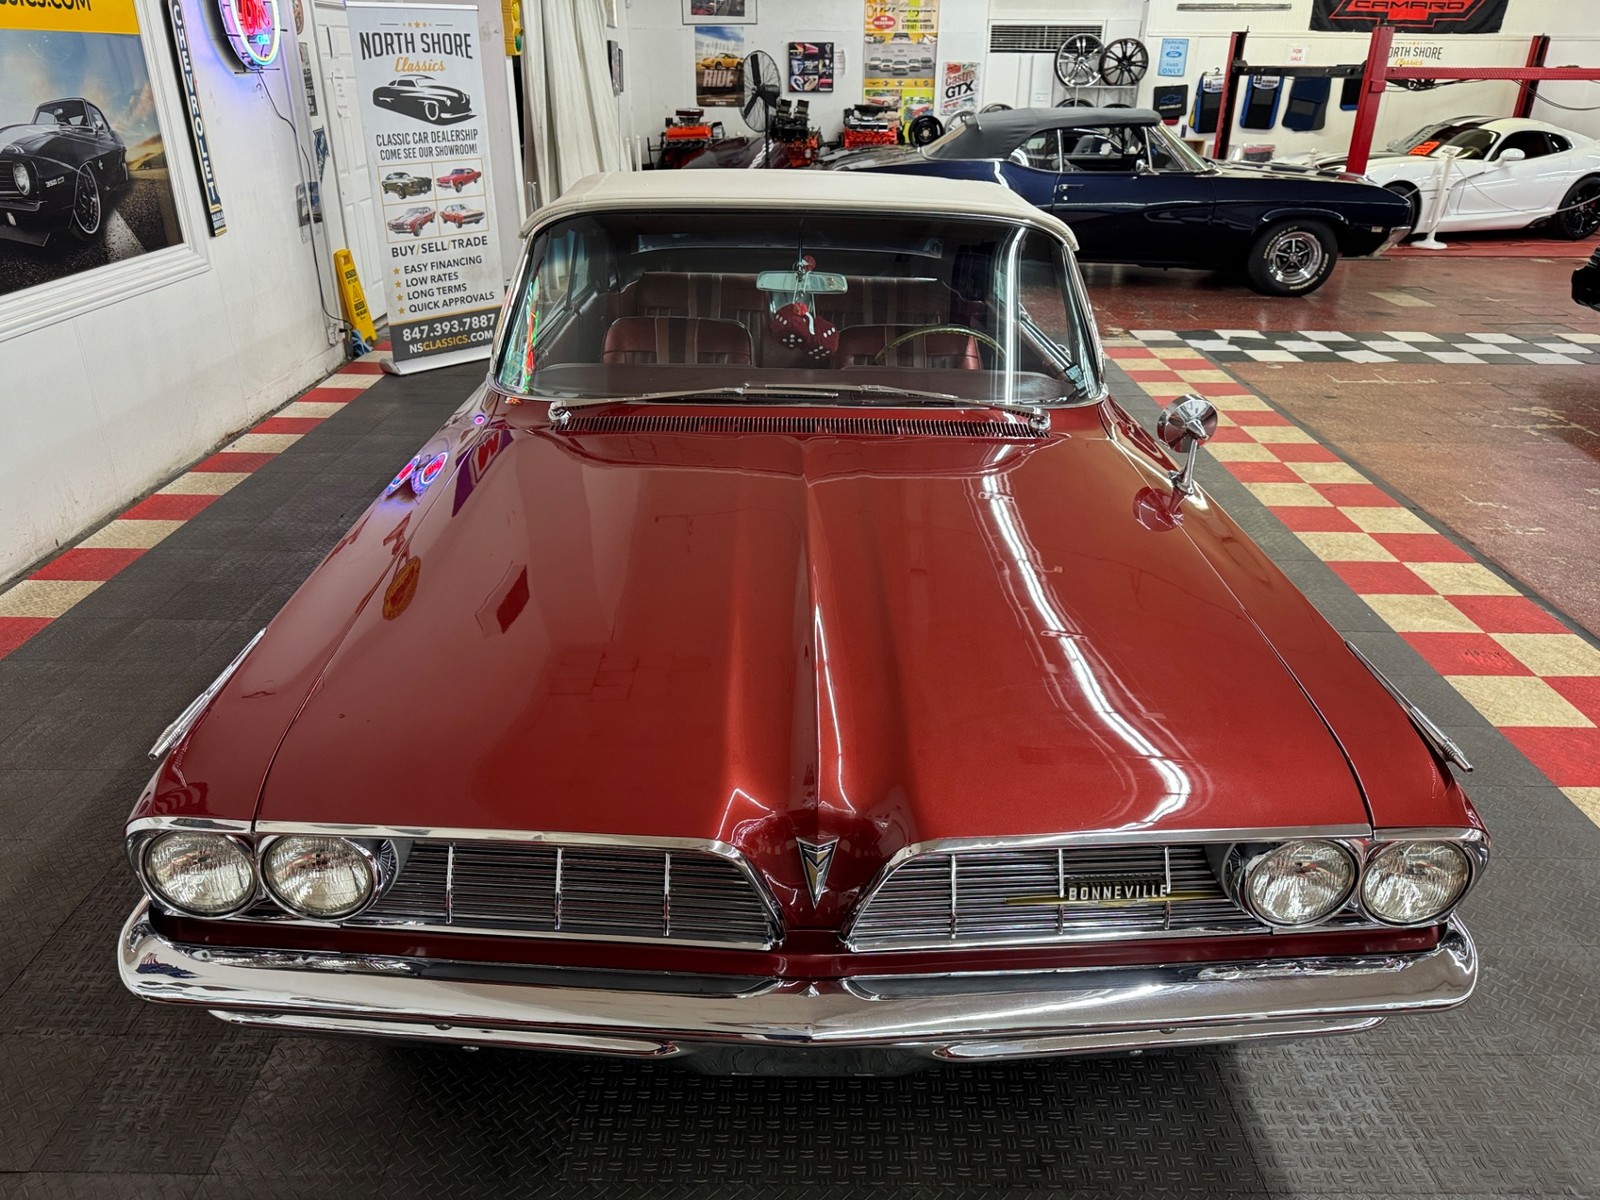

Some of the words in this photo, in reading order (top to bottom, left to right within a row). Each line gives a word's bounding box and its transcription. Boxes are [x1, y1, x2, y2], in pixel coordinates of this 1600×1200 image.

[1354, 0, 1465, 10] CAMARO
[359, 32, 416, 60] NORTH
[420, 33, 473, 60] SHORE
[1388, 46, 1410, 59] ORTH
[1413, 46, 1443, 60] SHORE
[394, 56, 446, 73] Classics
[703, 70, 734, 88] RIDE
[945, 70, 976, 87] Castro
[945, 80, 974, 99] GTX
[173, 5, 216, 200] CHEVROLET
[376, 132, 411, 147] CLASSIC
[412, 131, 429, 145] CAR
[431, 128, 478, 143] DEALERSHIP
[380, 148, 401, 161] COME
[403, 147, 417, 159] SEE
[419, 146, 434, 158] OUR
[435, 144, 478, 157] SHOWROOM!
[404, 263, 428, 275] EASY
[430, 255, 482, 271] FINANCING
[405, 276, 429, 288] LOW
[430, 272, 459, 284] RATES
[407, 289, 435, 301] LONG
[436, 283, 467, 297] TERMS
[408, 300, 440, 313] QUICK
[442, 292, 495, 308] APPROVALS
[402, 313, 496, 342] 847.393.7887
[409, 330, 493, 354] NSCLASSICS.COM
[1068, 884, 1167, 901] BONNEVILLE
